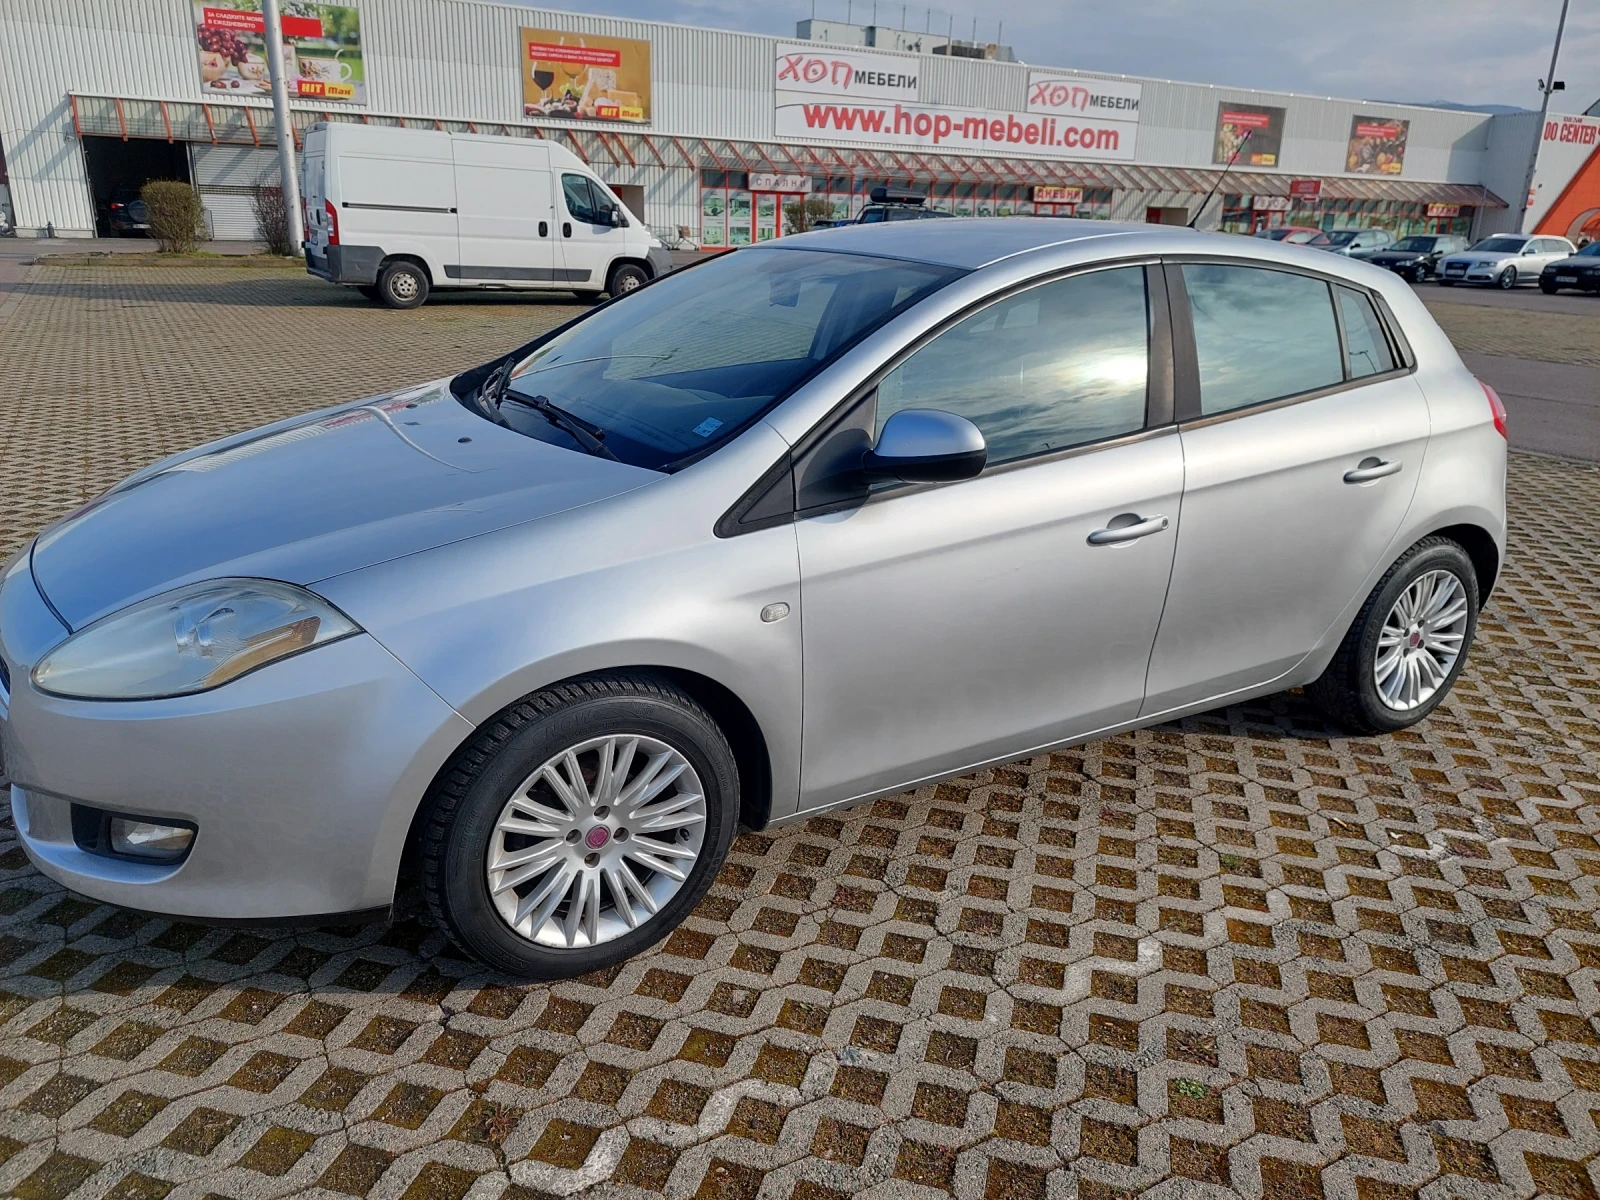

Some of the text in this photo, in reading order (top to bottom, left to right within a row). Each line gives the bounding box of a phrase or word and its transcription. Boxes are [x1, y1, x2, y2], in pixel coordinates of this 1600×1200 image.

[215, 12, 246, 21] СЛАДКИТЕ
[854, 71, 917, 90] МЕБЕЛИ
[301, 82, 322, 94] HIT
[1090, 94, 1139, 112] МЕБЕЛИ
[600, 107, 618, 117] HIT
[803, 103, 1119, 151] www.hop-mebeli.com
[1559, 123, 1597, 145] CENTER
[756, 178, 806, 188] СПАЛНИ
[1037, 188, 1080, 199] ДНЕВНИ
